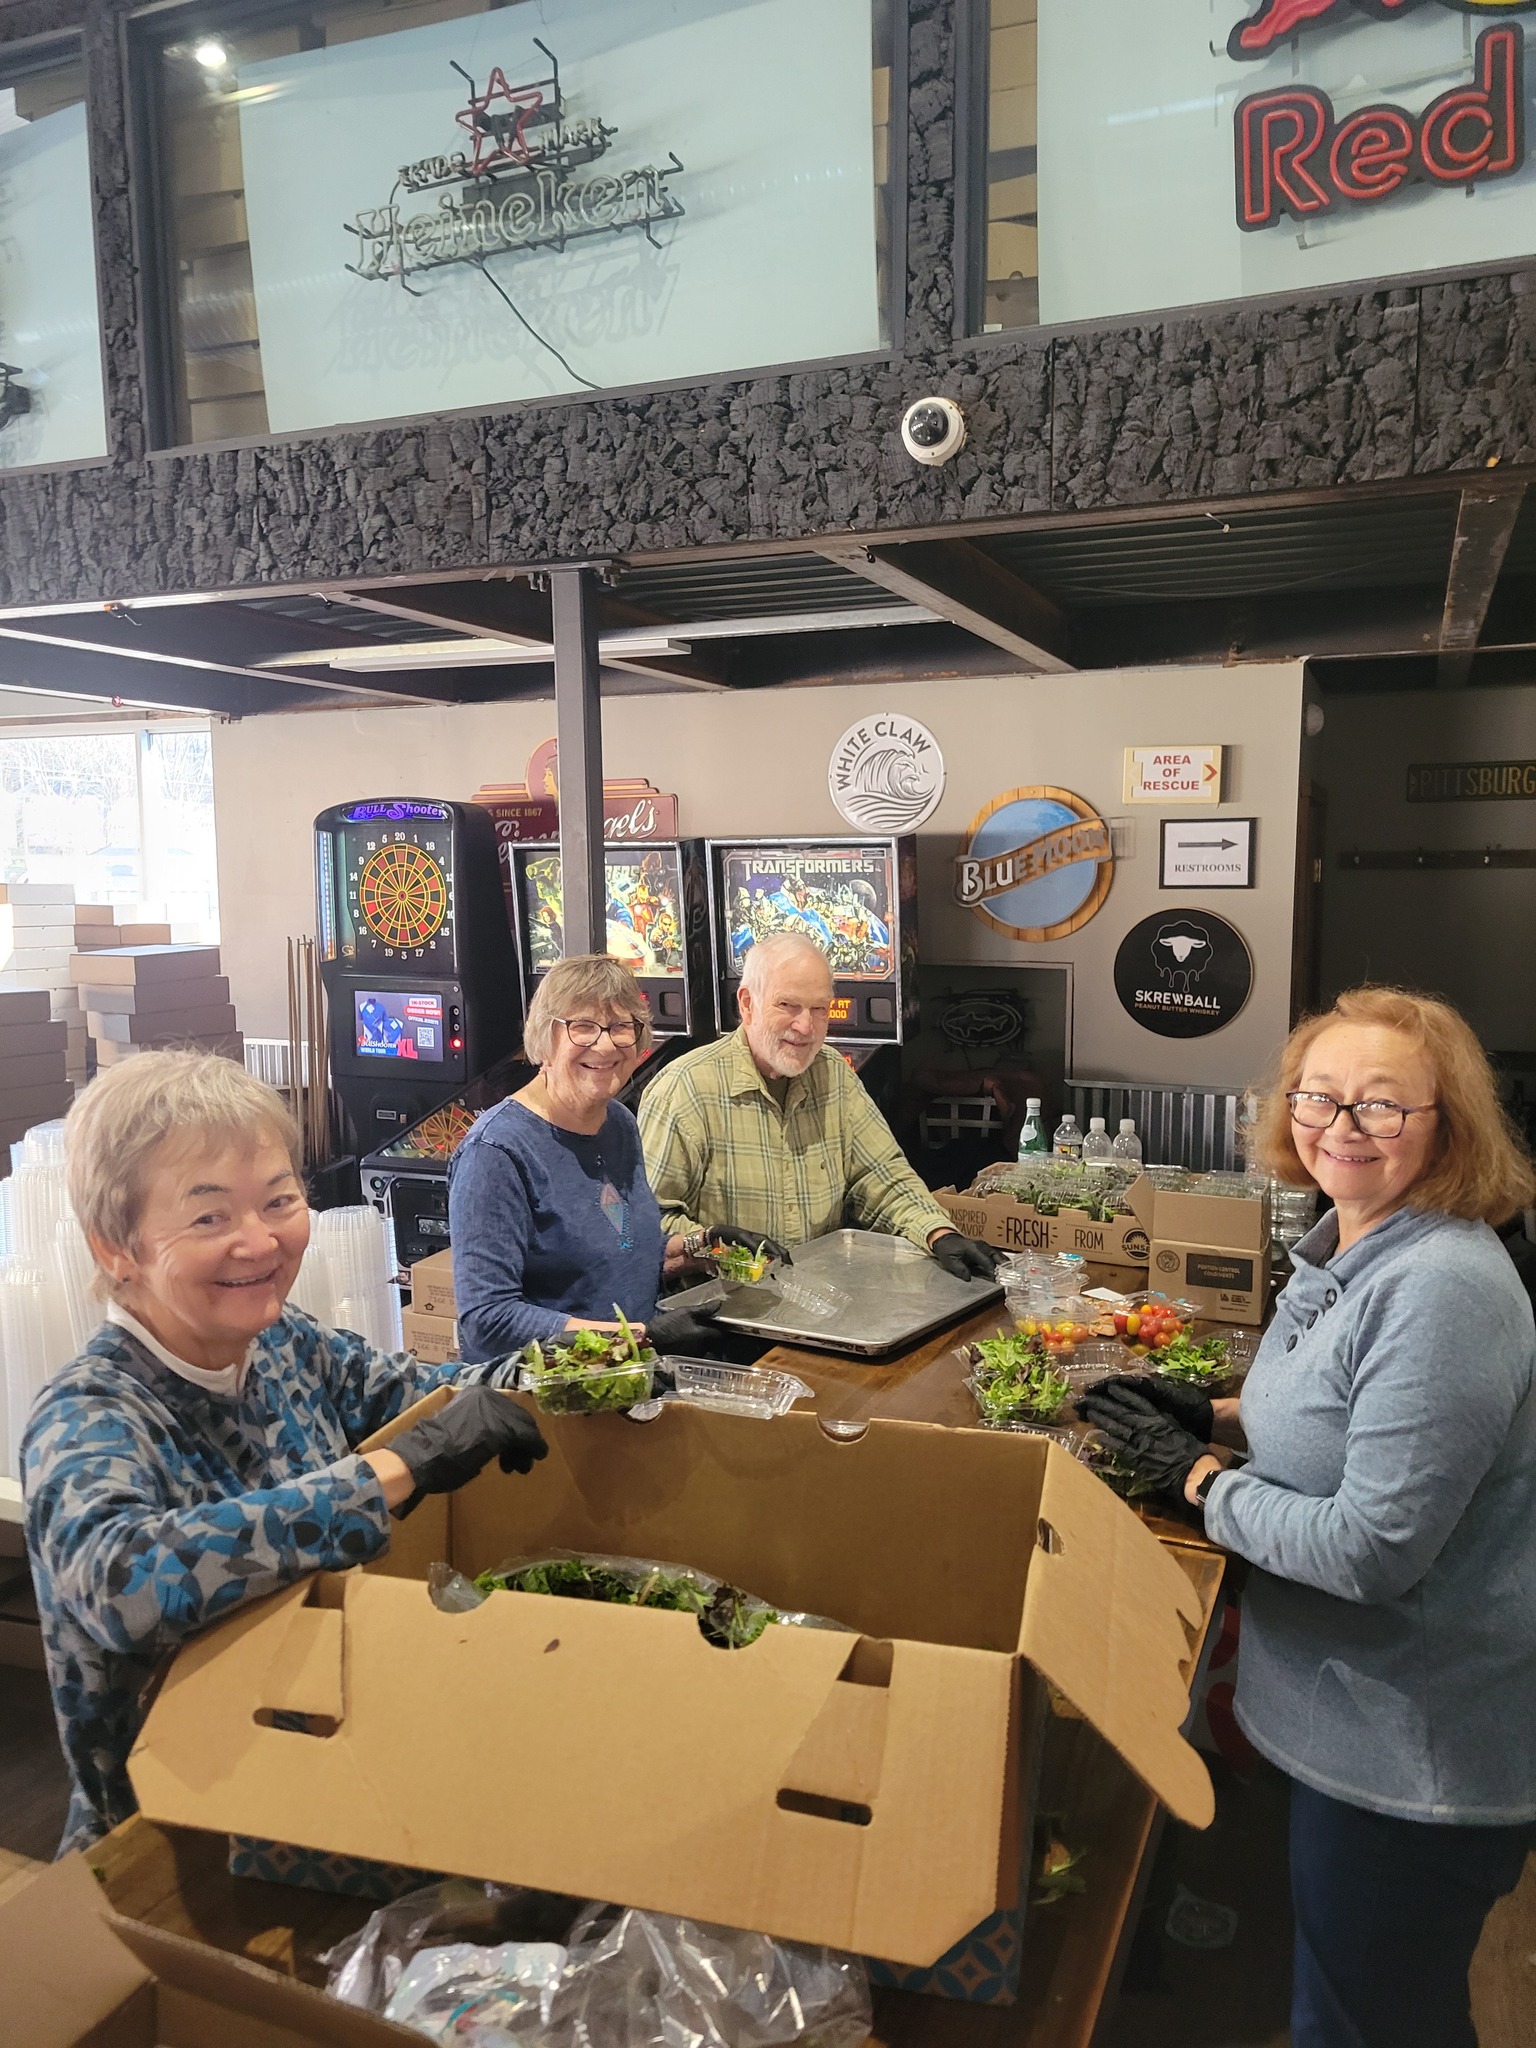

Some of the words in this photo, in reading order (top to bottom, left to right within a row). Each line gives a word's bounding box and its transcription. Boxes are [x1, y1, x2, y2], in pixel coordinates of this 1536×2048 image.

[1238, 28, 1517, 225] Red
[355, 164, 665, 273] Heineken
[836, 728, 871, 791] WHITE
[874, 721, 931, 754] CLAW
[1153, 755, 1191, 765] AREA
[1162, 768, 1181, 778] OF
[1143, 780, 1200, 791] RESCUE
[495, 808, 521, 817] SINCE
[382, 834, 388, 844] 5
[394, 832, 406, 841] 20
[366, 841, 376, 851] 12
[425, 841, 435, 850] 18
[358, 856, 365, 865] 9
[438, 856, 445, 865] 4
[741, 859, 874, 881] TRANSFORMERS
[1174, 864, 1242, 872] RESTROOMS
[349, 872, 358, 881] 14
[962, 854, 1027, 901] BLUE
[349, 891, 357, 899] 11
[353, 909, 360, 918] 8
[358, 926, 367, 935] 16
[440, 927, 450, 936] 15
[371, 940, 377, 948] 7
[429, 940, 436, 949] 2
[384, 948, 394, 957] 19
[415, 948, 424, 957] 17
[1135, 989, 1221, 1009] SKREWBALL
[838, 1000, 851, 1008] AT
[1134, 1003, 1160, 1011] PEANUT
[1162, 1005, 1188, 1013] BUTTER
[1189, 1007, 1220, 1016] WHISKEY
[397, 1039, 418, 1059] XL
[953, 1221, 985, 1238] AVOR
[1006, 1217, 1049, 1248] FRESH
[1074, 1229, 1104, 1251] FROM
[1121, 1244, 1150, 1253] SUNSE
